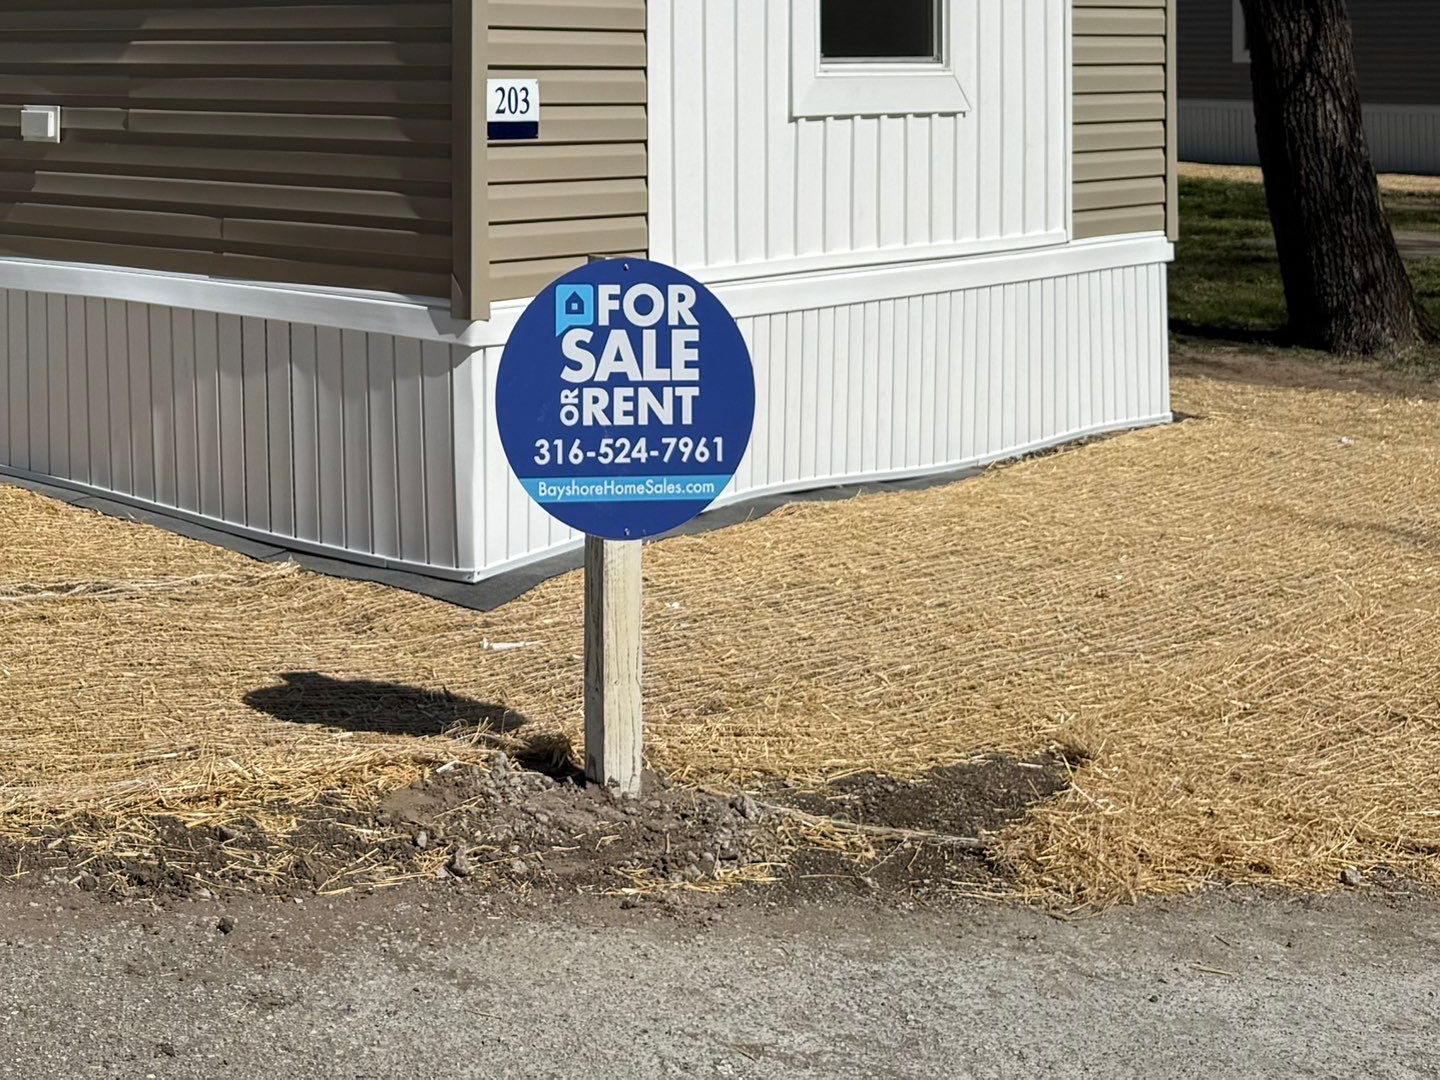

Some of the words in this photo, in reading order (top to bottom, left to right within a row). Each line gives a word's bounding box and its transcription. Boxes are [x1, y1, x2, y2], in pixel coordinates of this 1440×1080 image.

[494, 86, 531, 115] 203
[597, 283, 700, 327] FOR
[560, 328, 700, 383] SALE
[559, 387, 580, 427] OR
[582, 386, 700, 426] RENT
[533, 436, 724, 465] 316-524-7961
[538, 478, 715, 501] BayshoreHomeSales.com
